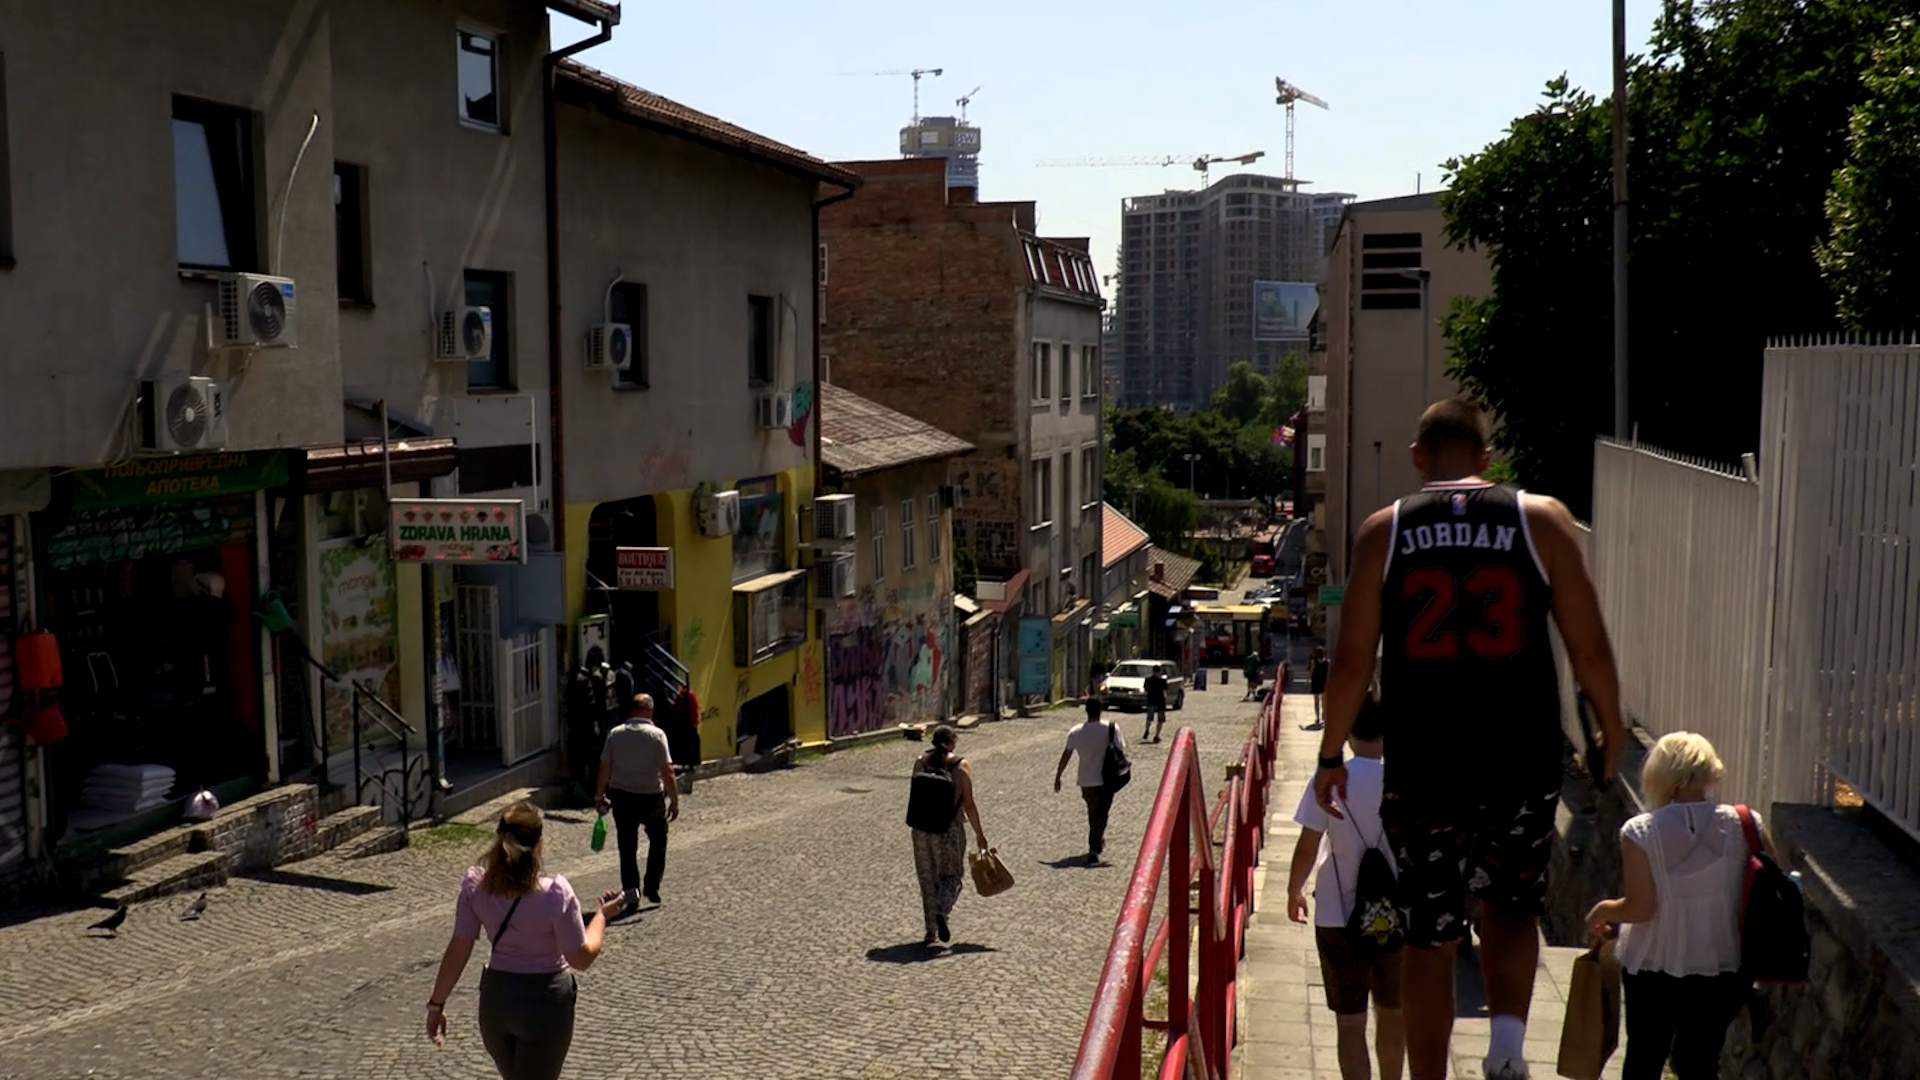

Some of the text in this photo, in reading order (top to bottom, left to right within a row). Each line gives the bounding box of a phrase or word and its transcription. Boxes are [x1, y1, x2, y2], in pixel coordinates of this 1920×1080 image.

[145, 474, 221, 497] АПОТЕКА
[399, 525, 511, 540] ZDRAVA HRANA
[1401, 521, 1518, 556] JORDAN
[618, 552, 666, 568] BOUTIQUE
[1402, 564, 1526, 661] 23
